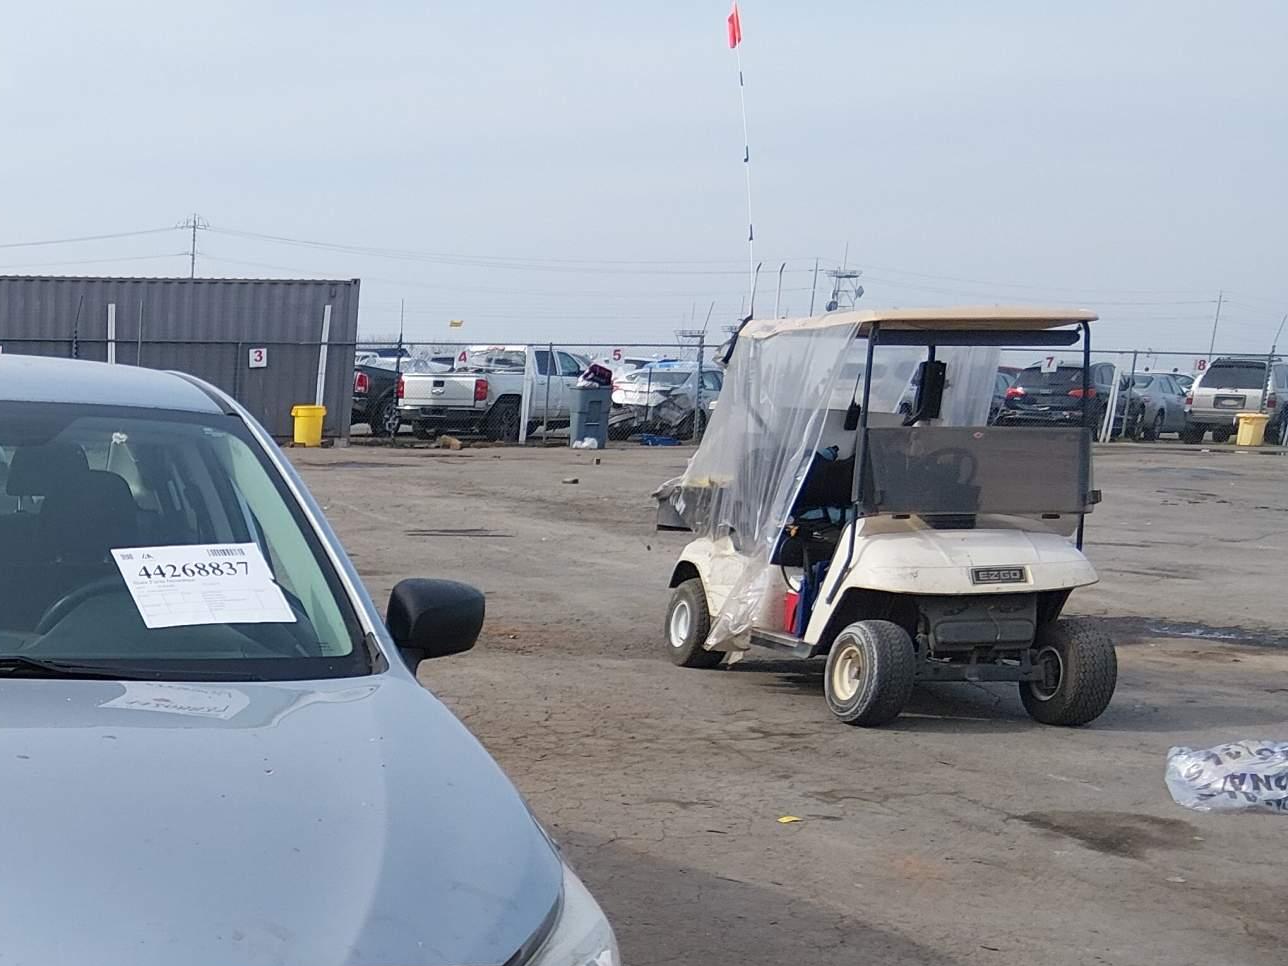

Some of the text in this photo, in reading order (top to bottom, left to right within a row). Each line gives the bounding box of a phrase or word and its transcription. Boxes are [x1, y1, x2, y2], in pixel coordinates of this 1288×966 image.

[254, 350, 263, 362] 3
[458, 351, 467, 363] 4
[613, 349, 621, 361] 5
[1046, 356, 1054, 368] 7
[1197, 359, 1206, 371] 8
[138, 561, 249, 579] 44268837
